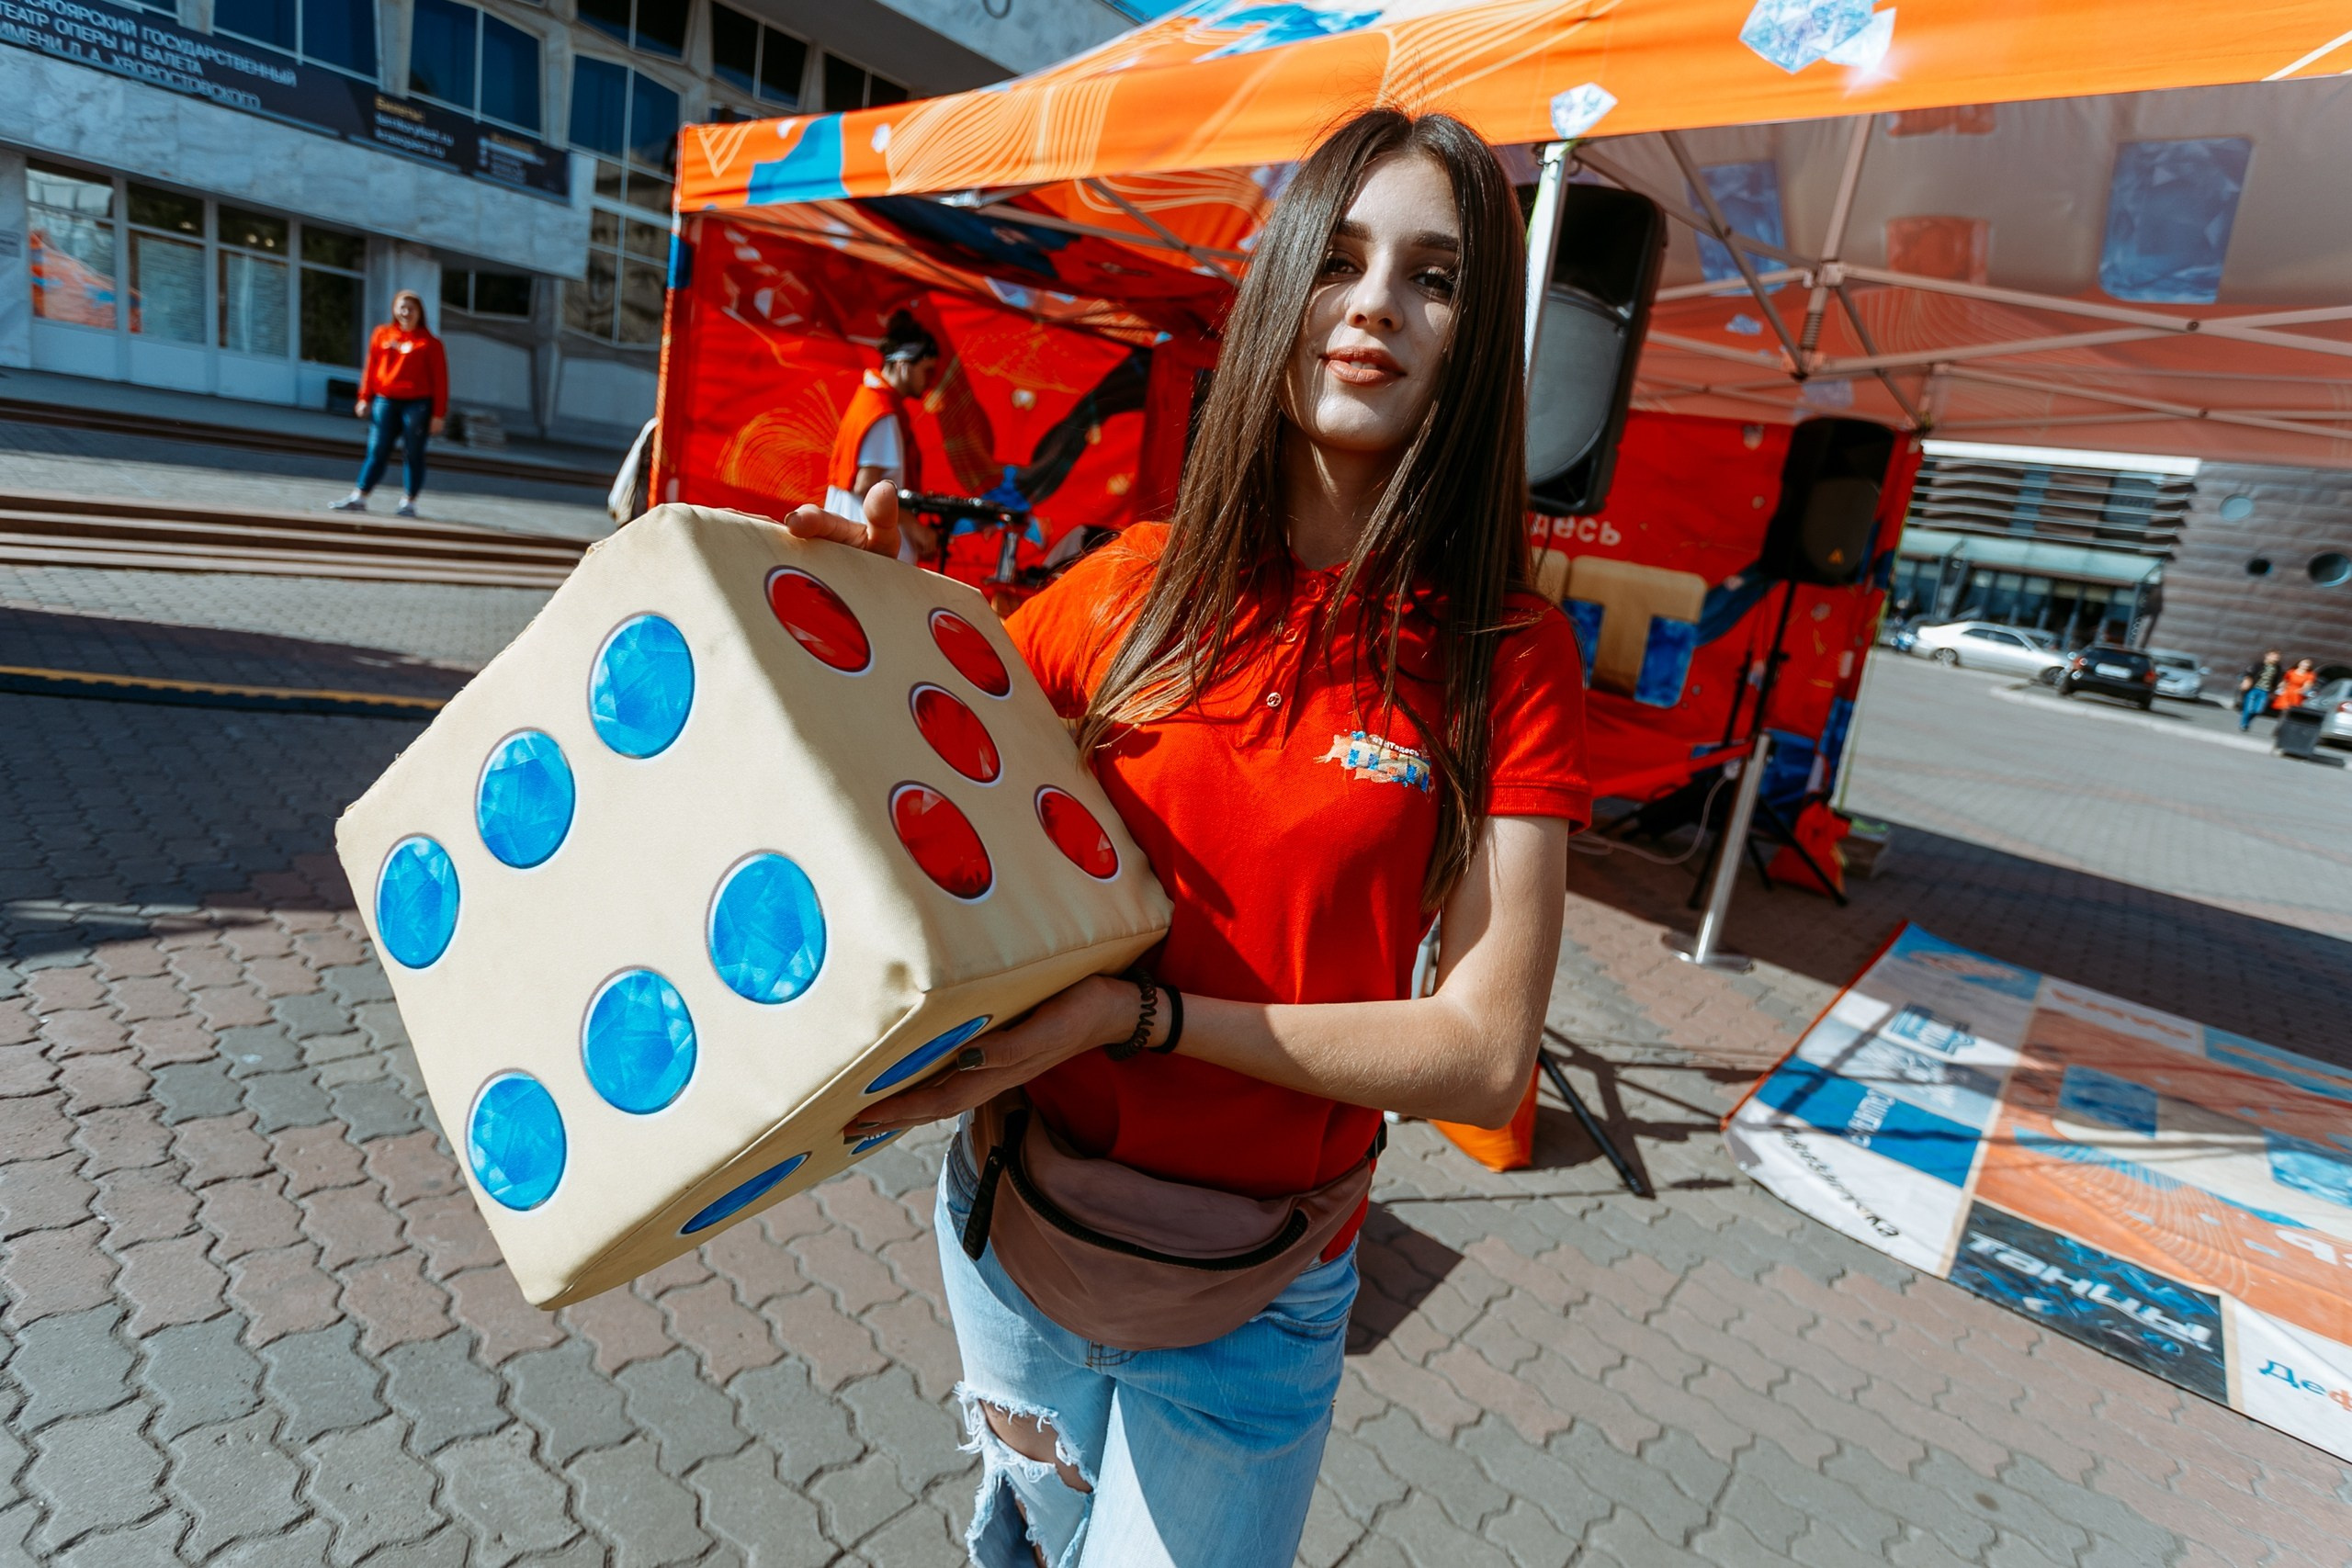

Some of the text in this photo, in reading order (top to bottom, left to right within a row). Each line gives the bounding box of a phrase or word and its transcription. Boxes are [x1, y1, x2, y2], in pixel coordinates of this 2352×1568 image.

[53, 18, 119, 51] ОПЕРЫ
[121, 38, 137, 56] И
[141, 43, 204, 77] БАЛЕТА
[141, 25, 298, 87] ГОСУДАРСТВЕННЫЙ
[1530, 513, 1622, 547] десь
